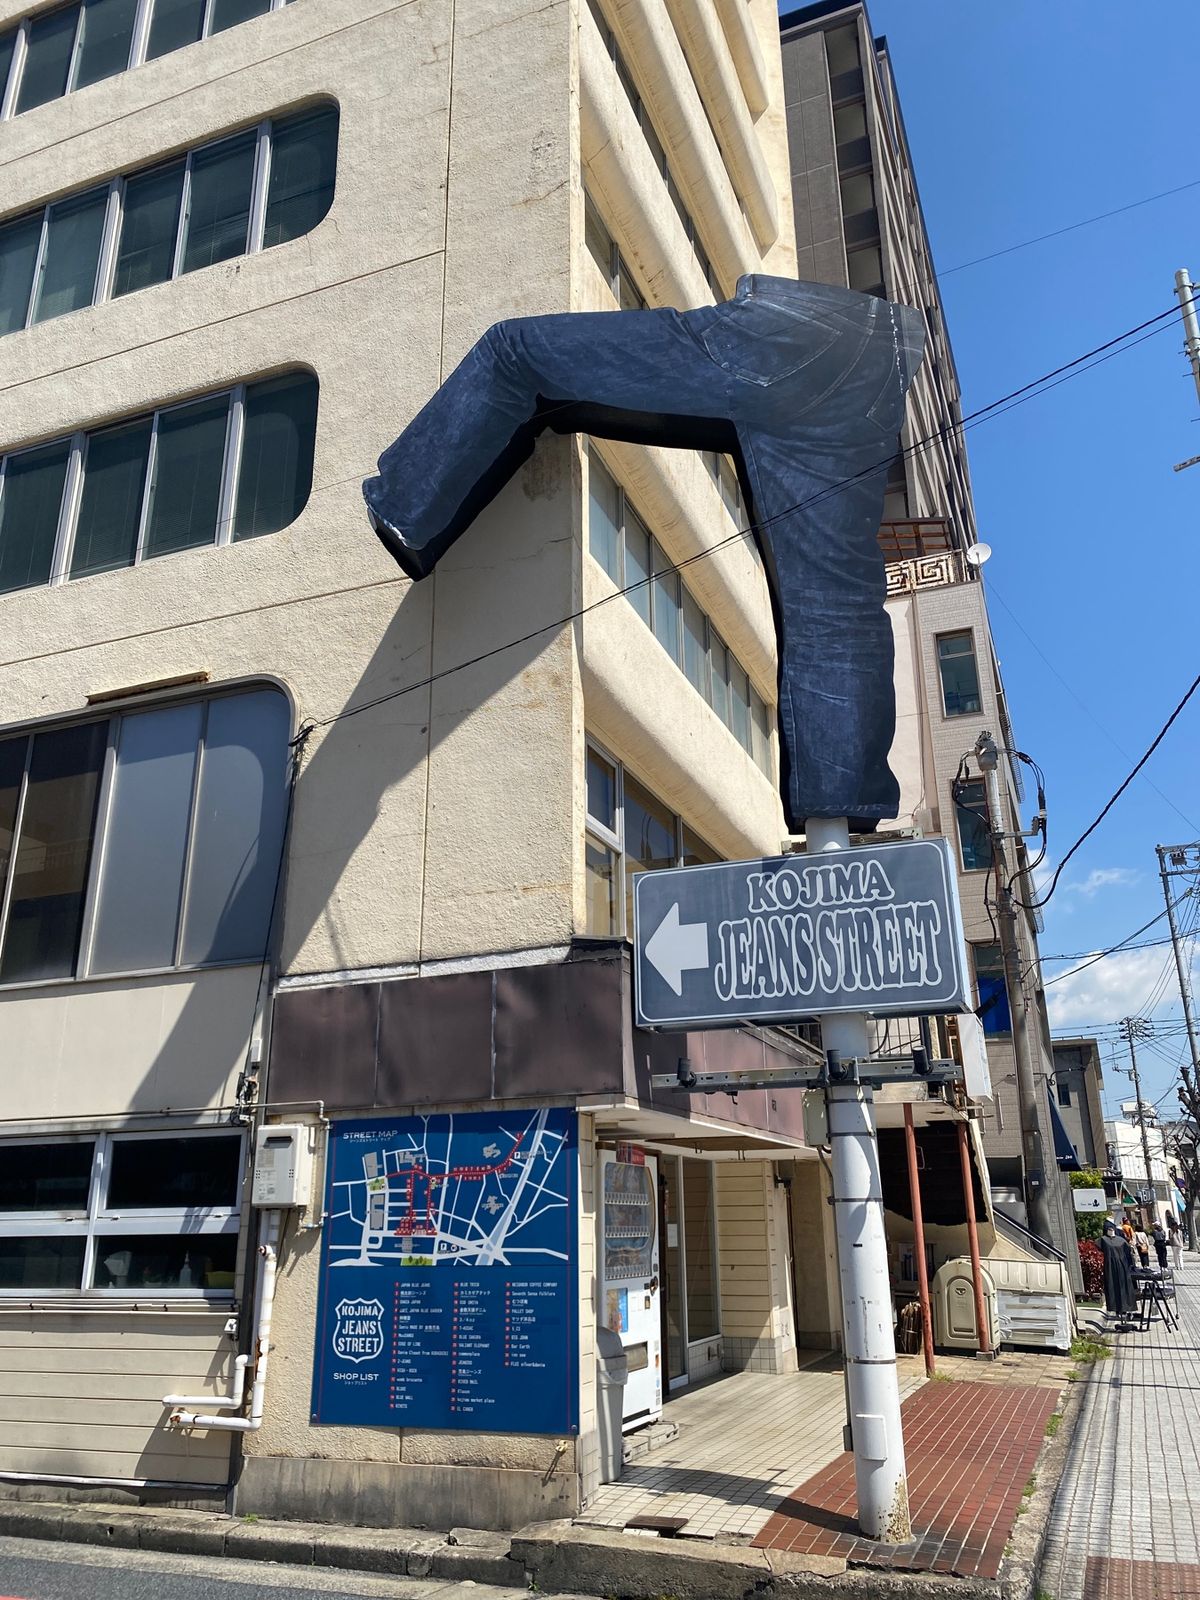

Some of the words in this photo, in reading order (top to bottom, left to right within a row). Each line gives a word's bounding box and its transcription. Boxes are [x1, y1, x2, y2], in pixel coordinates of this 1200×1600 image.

[748, 859, 895, 913] KOJIMA
[343, 1131, 377, 1139] STREET
[378, 1129, 398, 1137] MAP
[341, 1305, 378, 1316] KOJIMA
[342, 1320, 377, 1335] JEANS
[337, 1337, 379, 1353] STREET
[333, 1372, 358, 1380] SHOP
[360, 1373, 379, 1381] LIST
